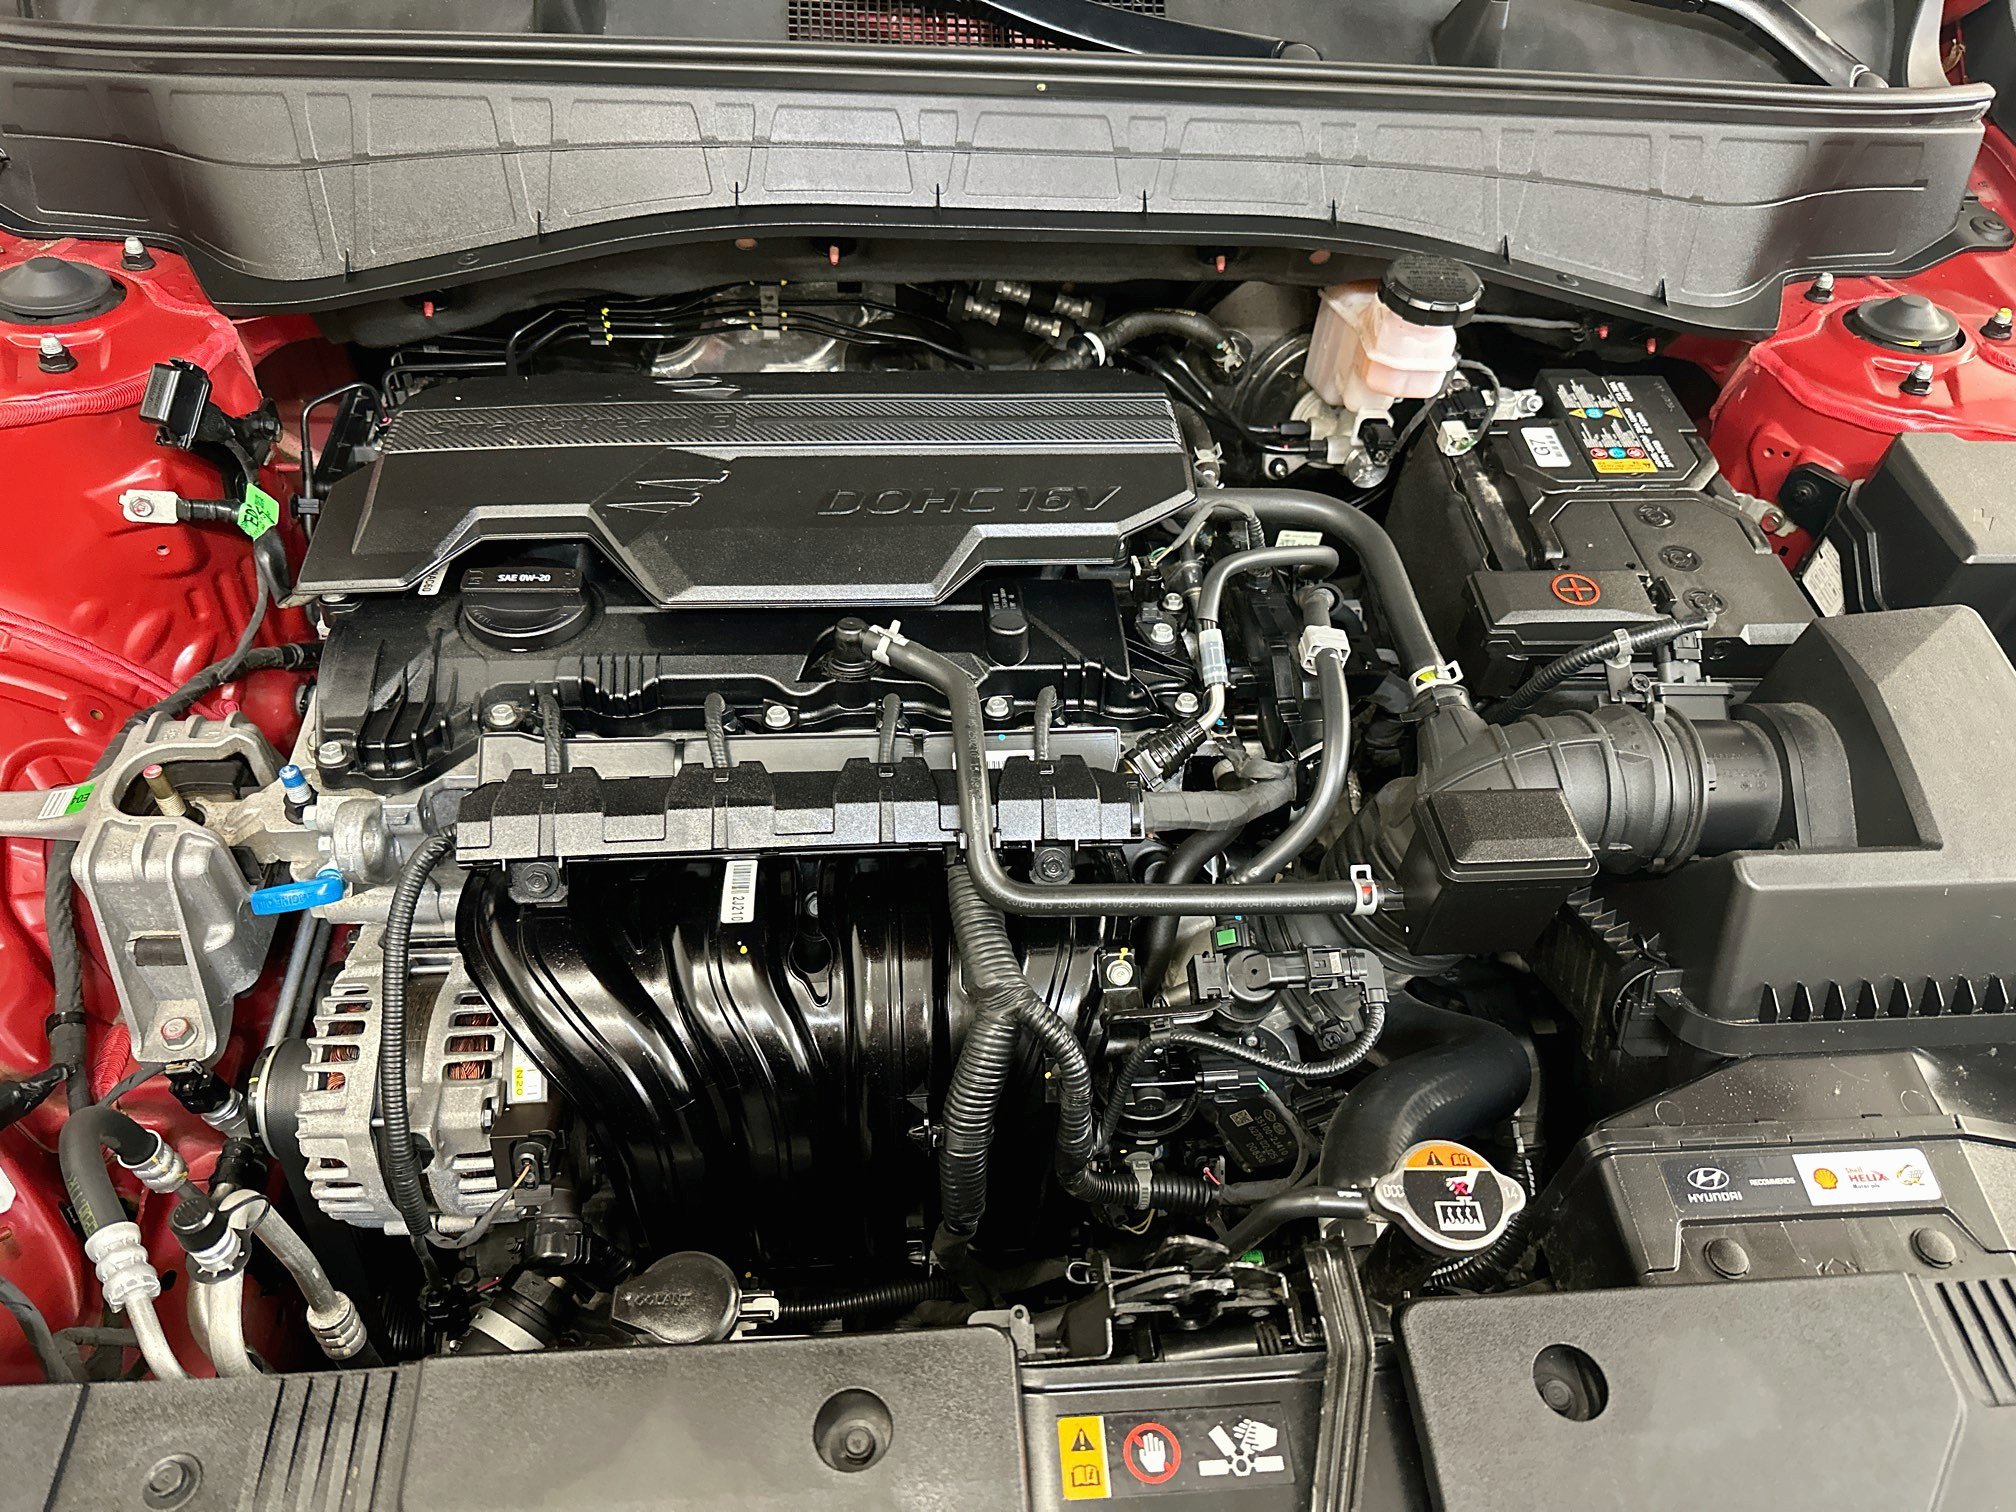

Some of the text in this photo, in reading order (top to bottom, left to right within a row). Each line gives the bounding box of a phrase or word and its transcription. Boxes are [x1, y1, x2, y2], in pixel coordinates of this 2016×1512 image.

[817, 486, 1122, 515] DOHC 16V
[497, 574, 551, 582] SAE 0W-20
[731, 896, 745, 921] 2J210
[1749, 1177, 1796, 1186] RECOMMENDS
[1849, 1172, 1889, 1183] HELIX
[1687, 1191, 1743, 1203] HYUNDAI
